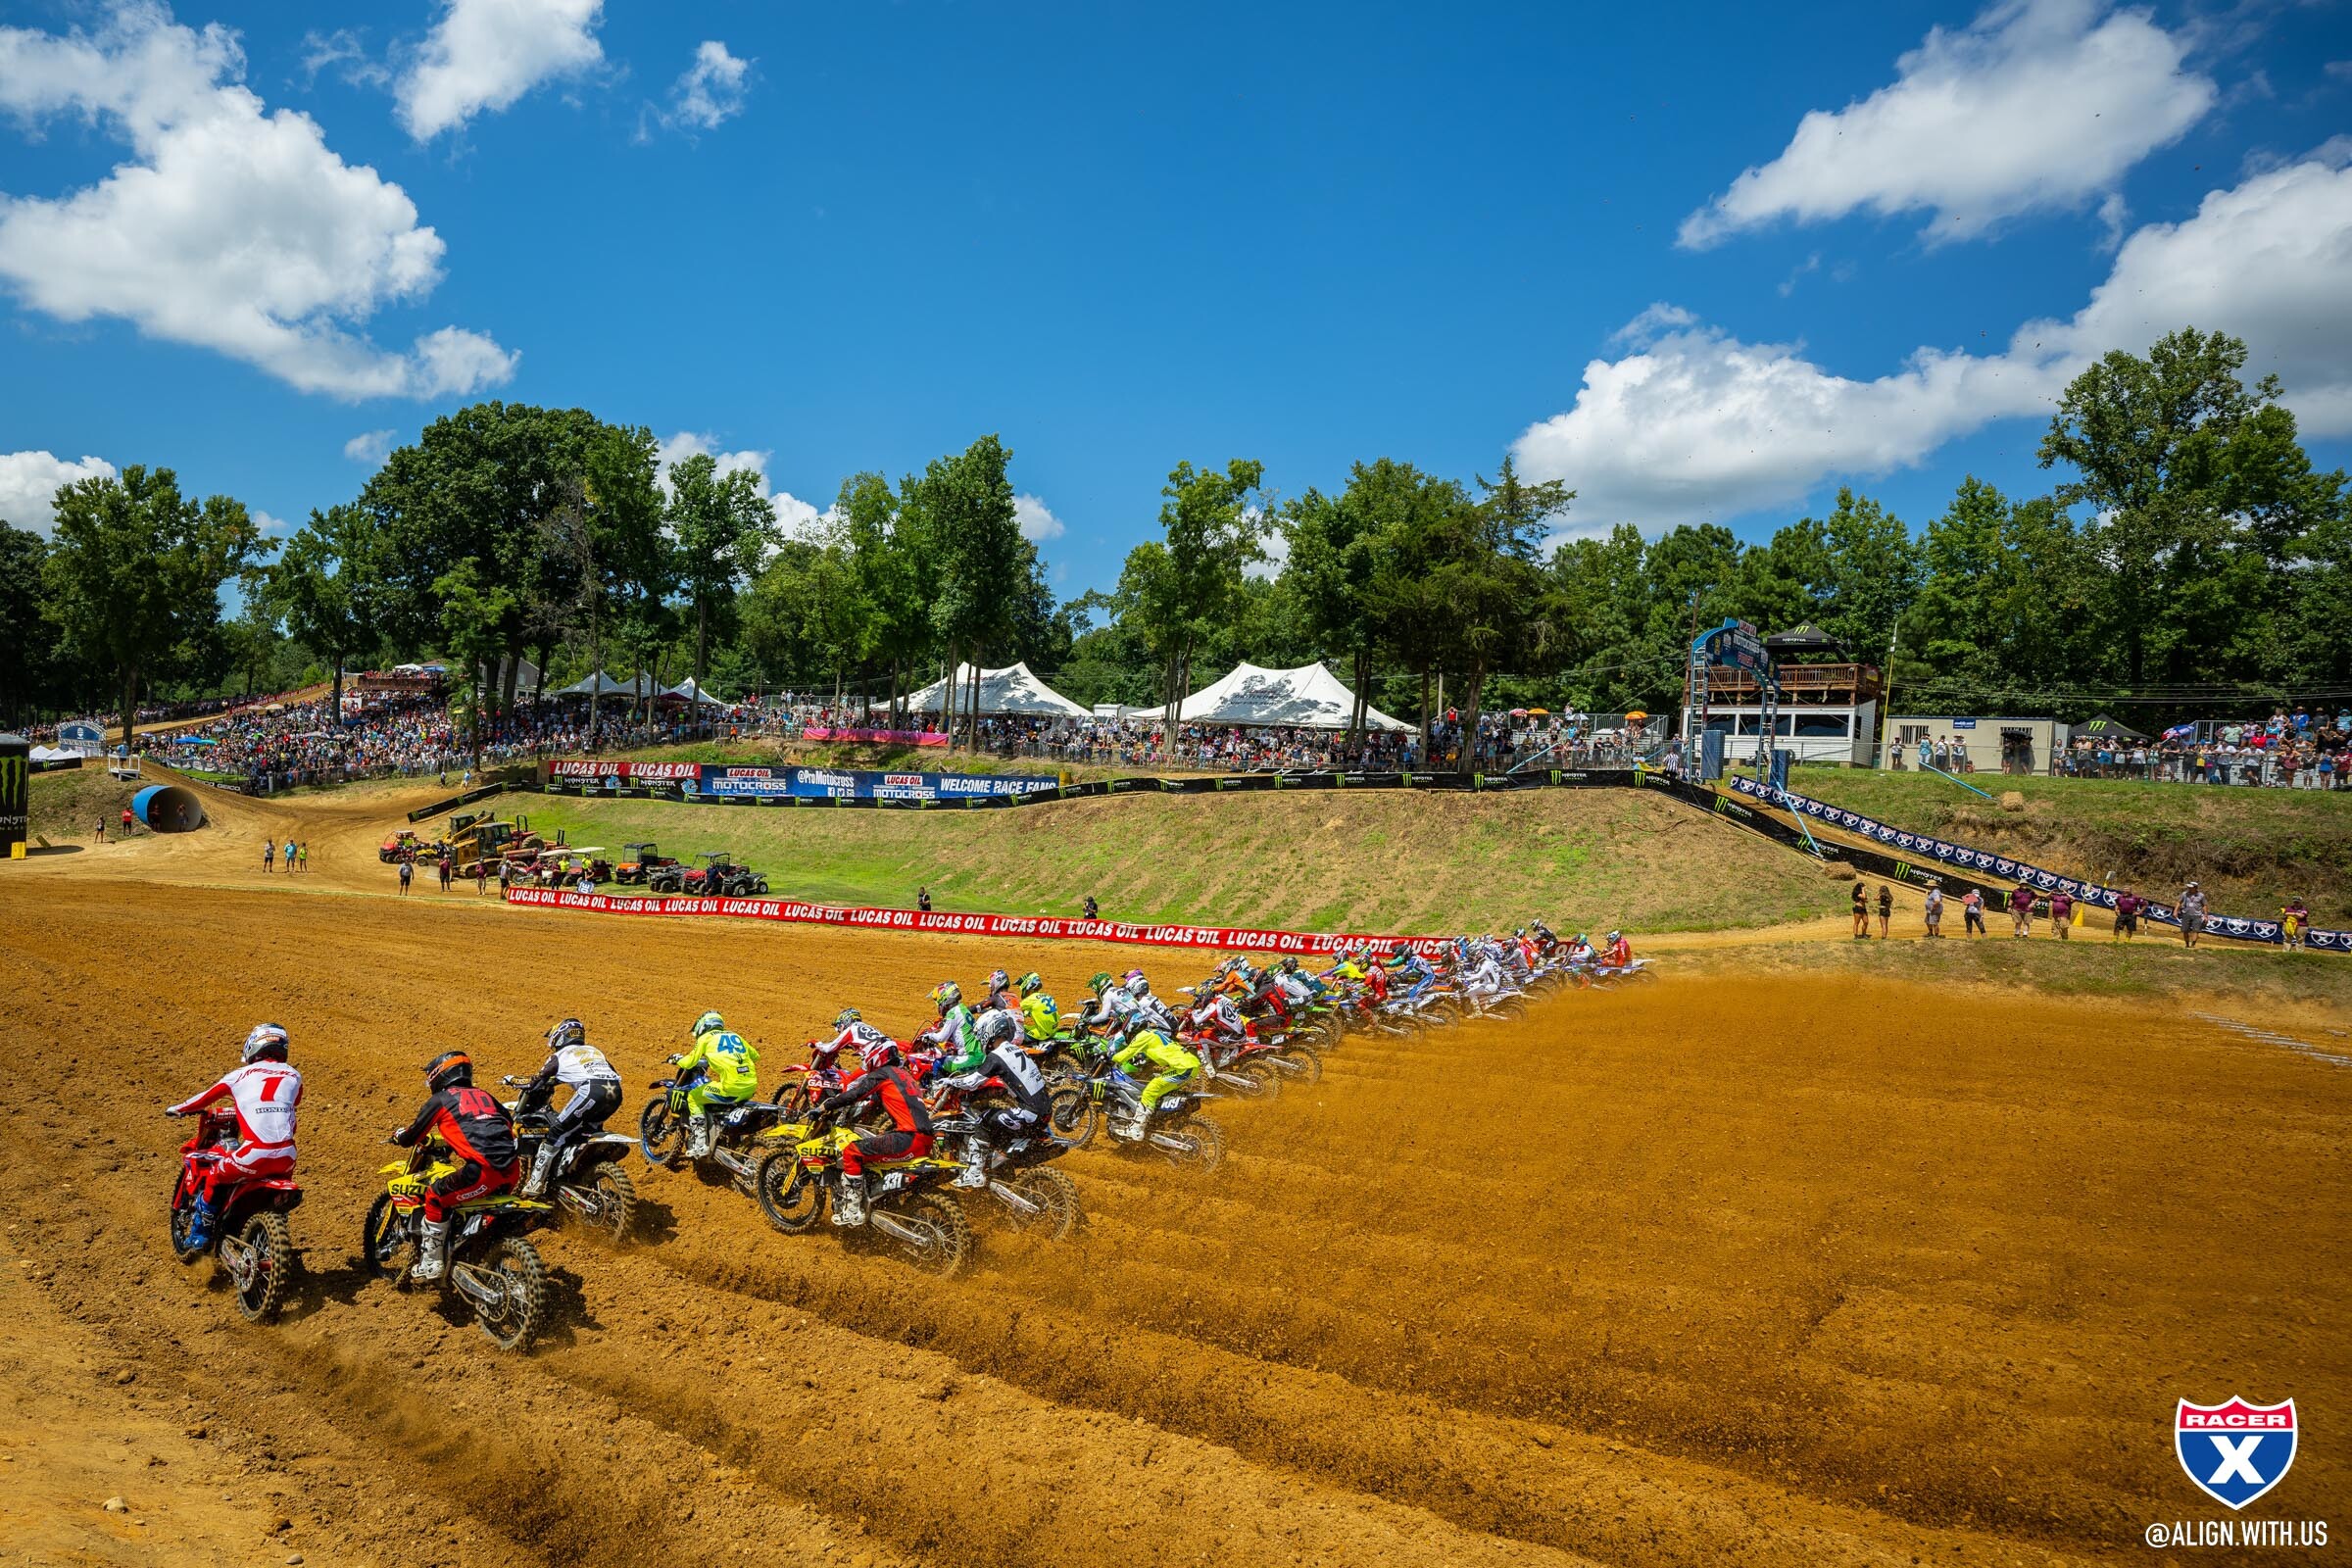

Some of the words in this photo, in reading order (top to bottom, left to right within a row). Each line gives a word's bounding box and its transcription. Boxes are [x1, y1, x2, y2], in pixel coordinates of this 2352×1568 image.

[554, 762, 597, 775] LUCAS
[599, 762, 619, 775] OIL
[629, 762, 671, 776] LUCAS
[674, 764, 695, 776] OIL
[712, 781, 787, 790] MOTOCROSS
[798, 769, 855, 788] @ProMotocross
[886, 776, 908, 785] LUCAS
[1646, 776, 1670, 786] MONSTER
[873, 788, 935, 799] MOTOCROSS
[941, 778, 991, 794] WELCOME
[993, 780, 1023, 795] RACE
[1727, 802, 1752, 817] MONSTER
[1910, 868, 1942, 882] MONSTER
[510, 889, 540, 903] LUCAS
[541, 891, 556, 904] OIL
[560, 893, 589, 907] LUCAS
[591, 896, 607, 908] OIL
[611, 898, 642, 911] LUCAS
[645, 900, 661, 911] OIL
[664, 899, 698, 912] LUCAS
[701, 900, 718, 912] OIL
[722, 901, 760, 915] LUCAS
[761, 904, 780, 915] OIL
[785, 905, 823, 920] LUCAS
[825, 909, 845, 921] OIL
[851, 909, 891, 924] LUCAS
[893, 912, 913, 925] OIL
[919, 913, 962, 929] LUCAS
[964, 916, 985, 930] OIL
[992, 917, 1036, 933] LUCAS
[1039, 919, 1061, 934] OIL
[1067, 921, 1113, 937] LUCAS
[1116, 925, 1139, 939] OIL
[1145, 927, 1193, 943] LUCAS
[1197, 930, 1220, 944] OIL
[1226, 931, 1277, 948] LUCAS
[1279, 935, 1304, 950] OIL
[1311, 936, 1365, 953] LUCAS
[1371, 939, 1394, 954] OIL
[717, 1035, 746, 1054] 49
[261, 1076, 284, 1102] 1
[808, 1079, 845, 1090] GASGA
[459, 1088, 497, 1117] 40
[728, 1108, 746, 1123] 49
[801, 1147, 843, 1157] SUZUK
[883, 1172, 903, 1191] 331
[391, 1184, 427, 1196] SUZU
[463, 1185, 487, 1199] SUZUKI
